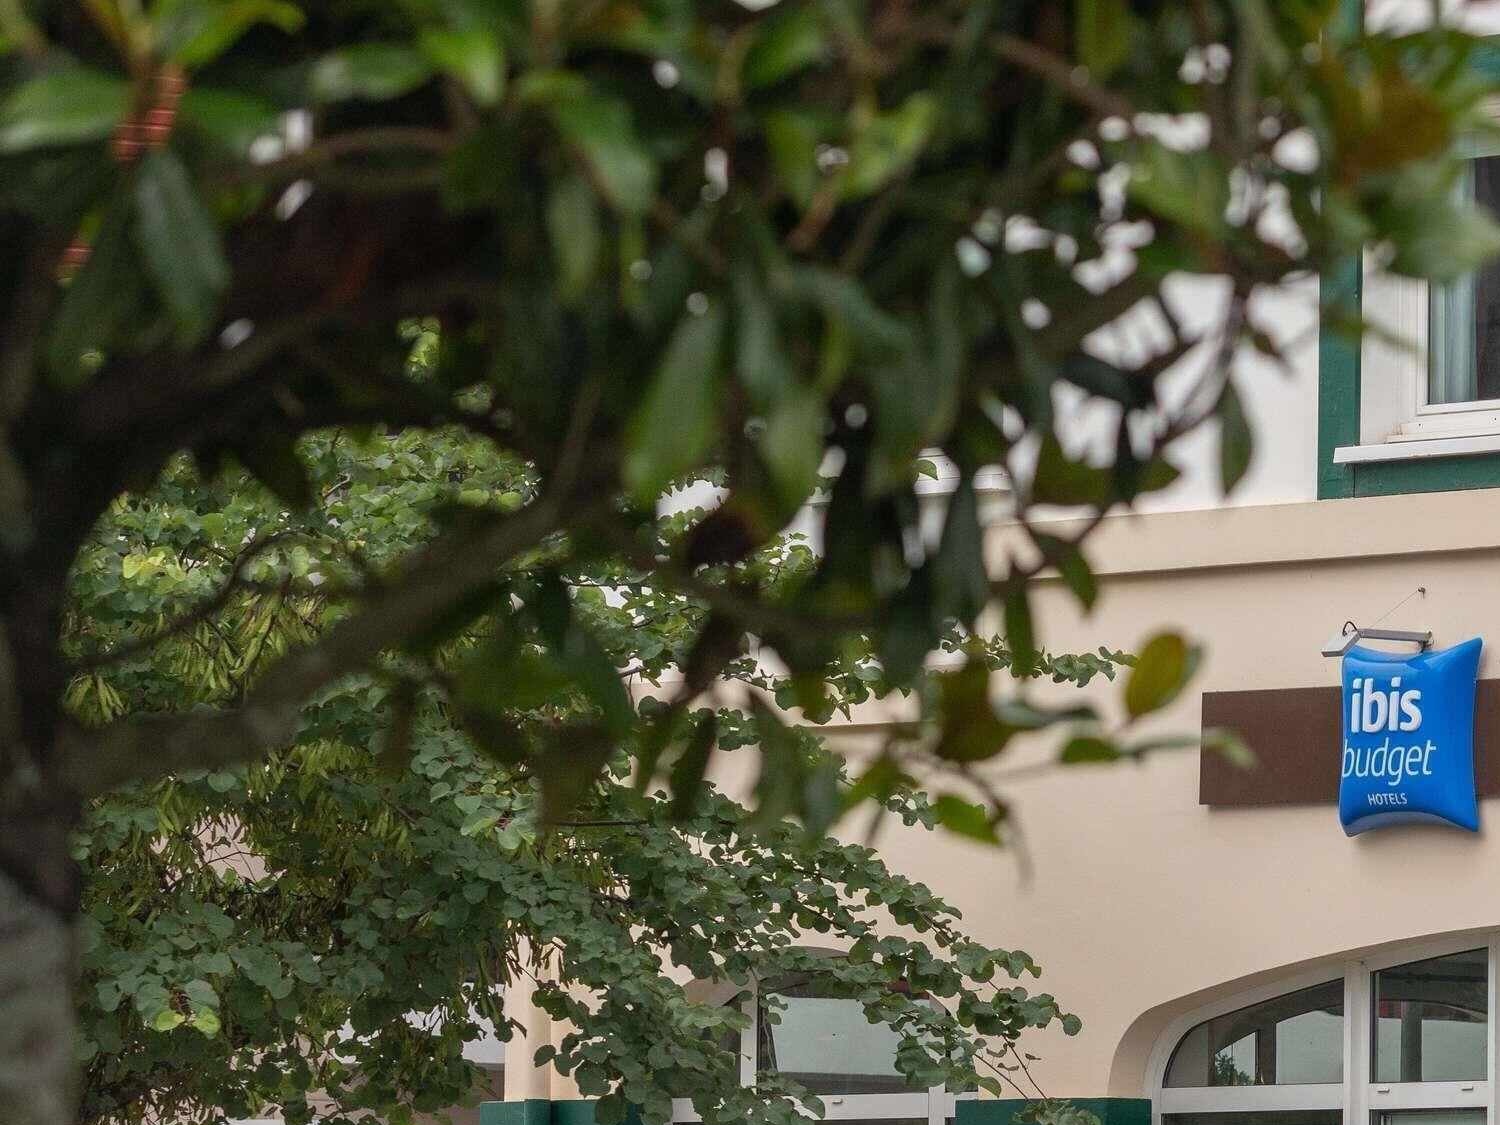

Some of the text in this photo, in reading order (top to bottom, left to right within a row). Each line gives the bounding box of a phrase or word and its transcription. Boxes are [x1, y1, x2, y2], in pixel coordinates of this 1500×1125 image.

[1351, 677, 1423, 734] ibis
[1342, 737, 1437, 786] budget
[1367, 792, 1408, 806] HOTELS
